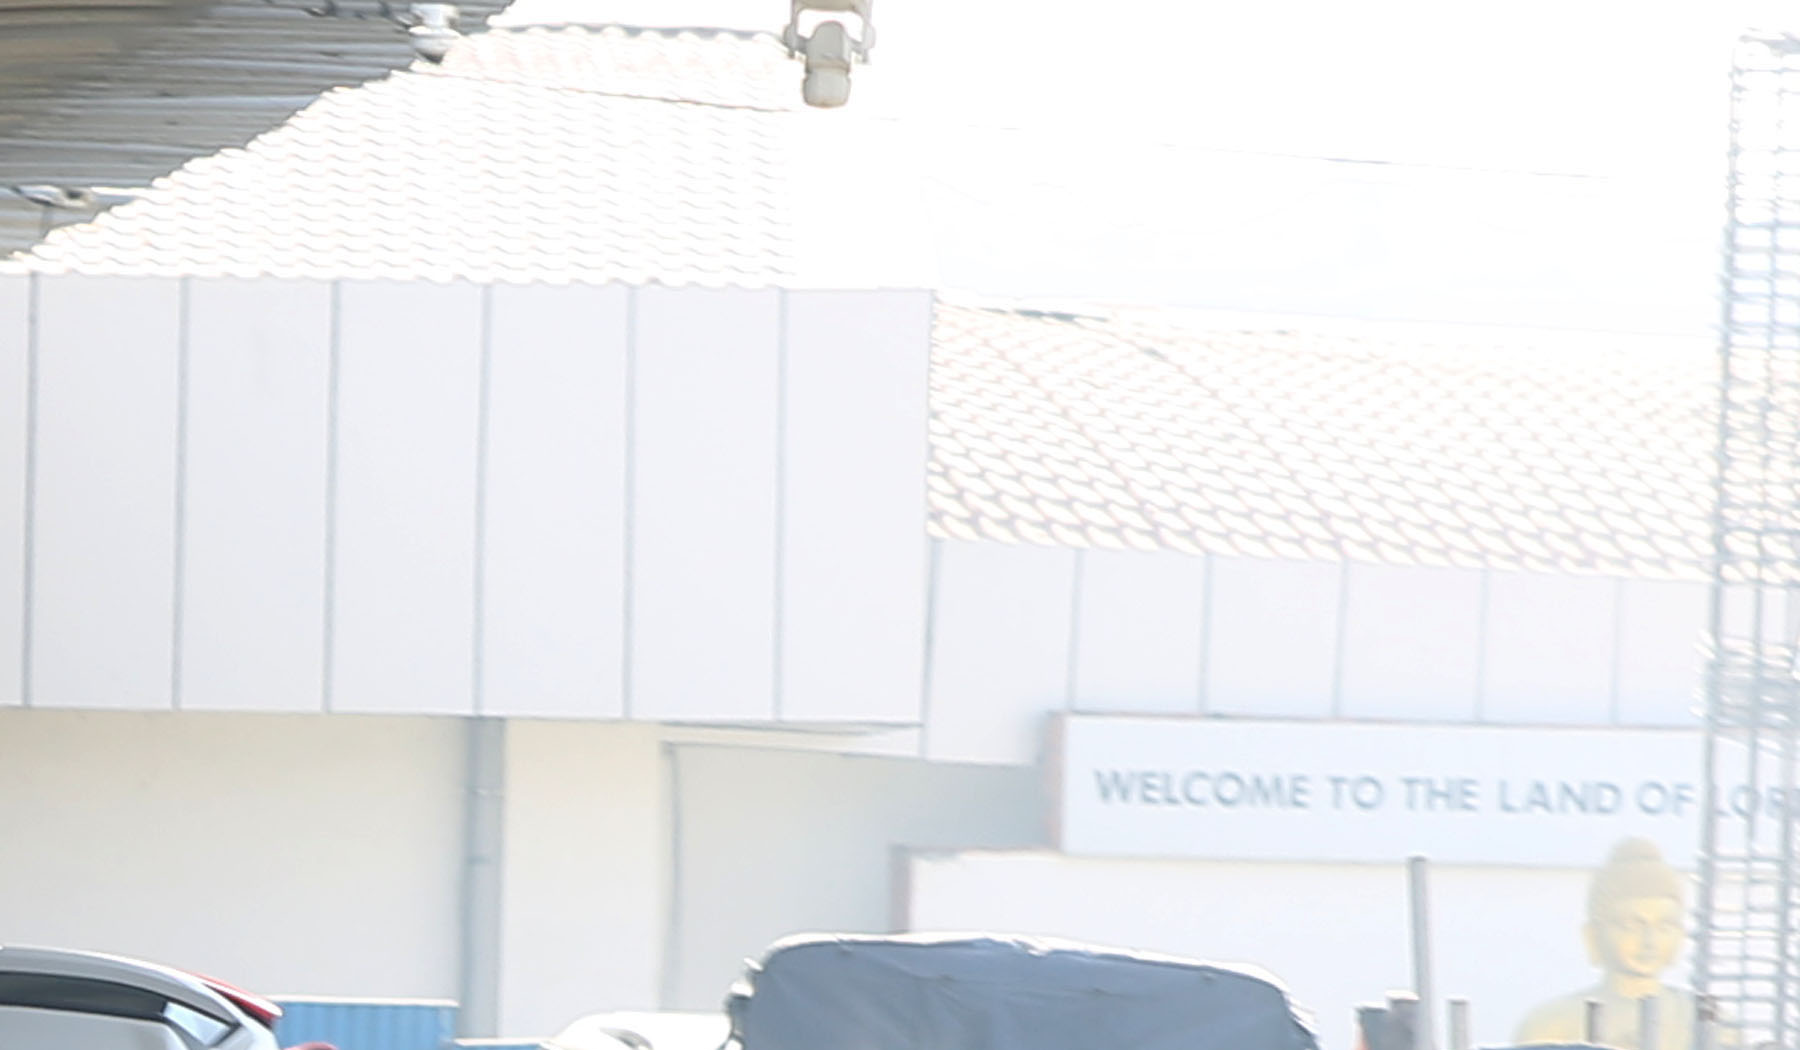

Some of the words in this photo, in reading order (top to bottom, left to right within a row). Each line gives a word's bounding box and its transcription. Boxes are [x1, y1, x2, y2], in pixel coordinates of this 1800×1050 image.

[1094, 769, 1311, 811] WELCOME
[1326, 773, 1387, 811] TO
[1400, 776, 1481, 813] THE
[1497, 778, 1625, 817] LAND
[1634, 781, 1696, 817] OF
